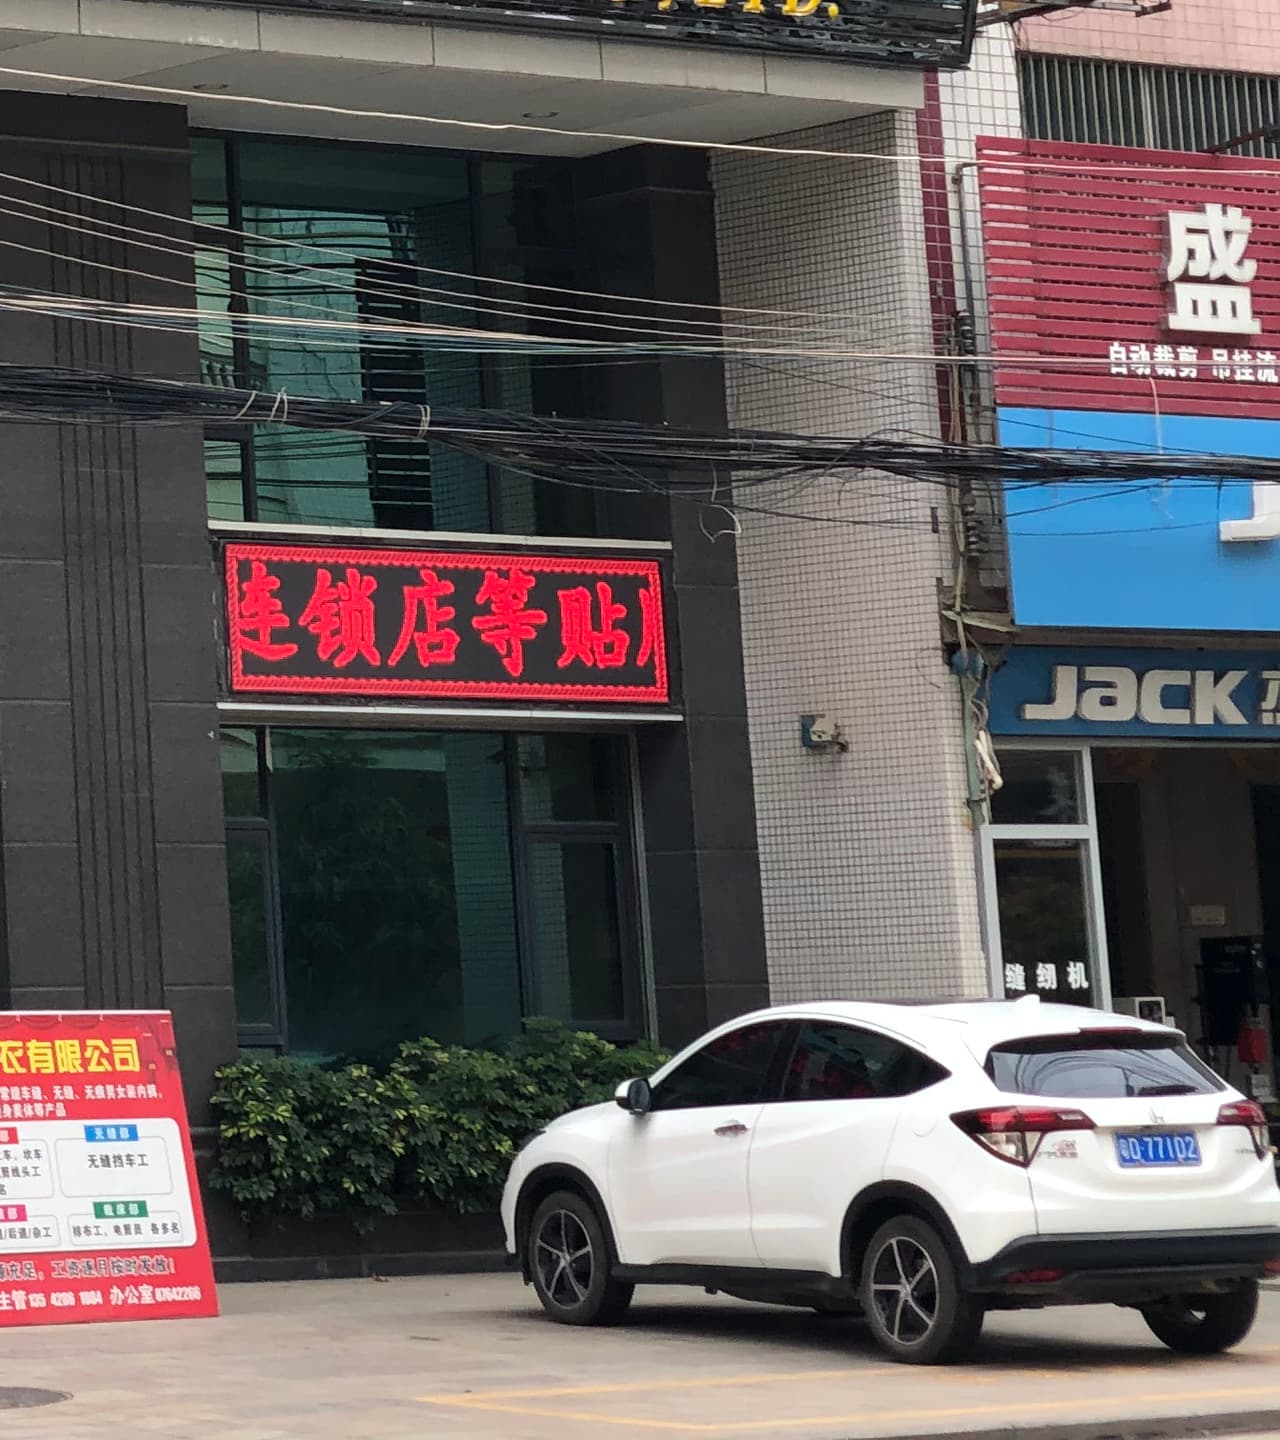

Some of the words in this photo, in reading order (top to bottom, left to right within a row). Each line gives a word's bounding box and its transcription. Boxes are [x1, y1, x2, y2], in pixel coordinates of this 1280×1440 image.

[1167, 202, 1262, 335] 盛
[1004, 961, 1089, 991] 缝纫机
